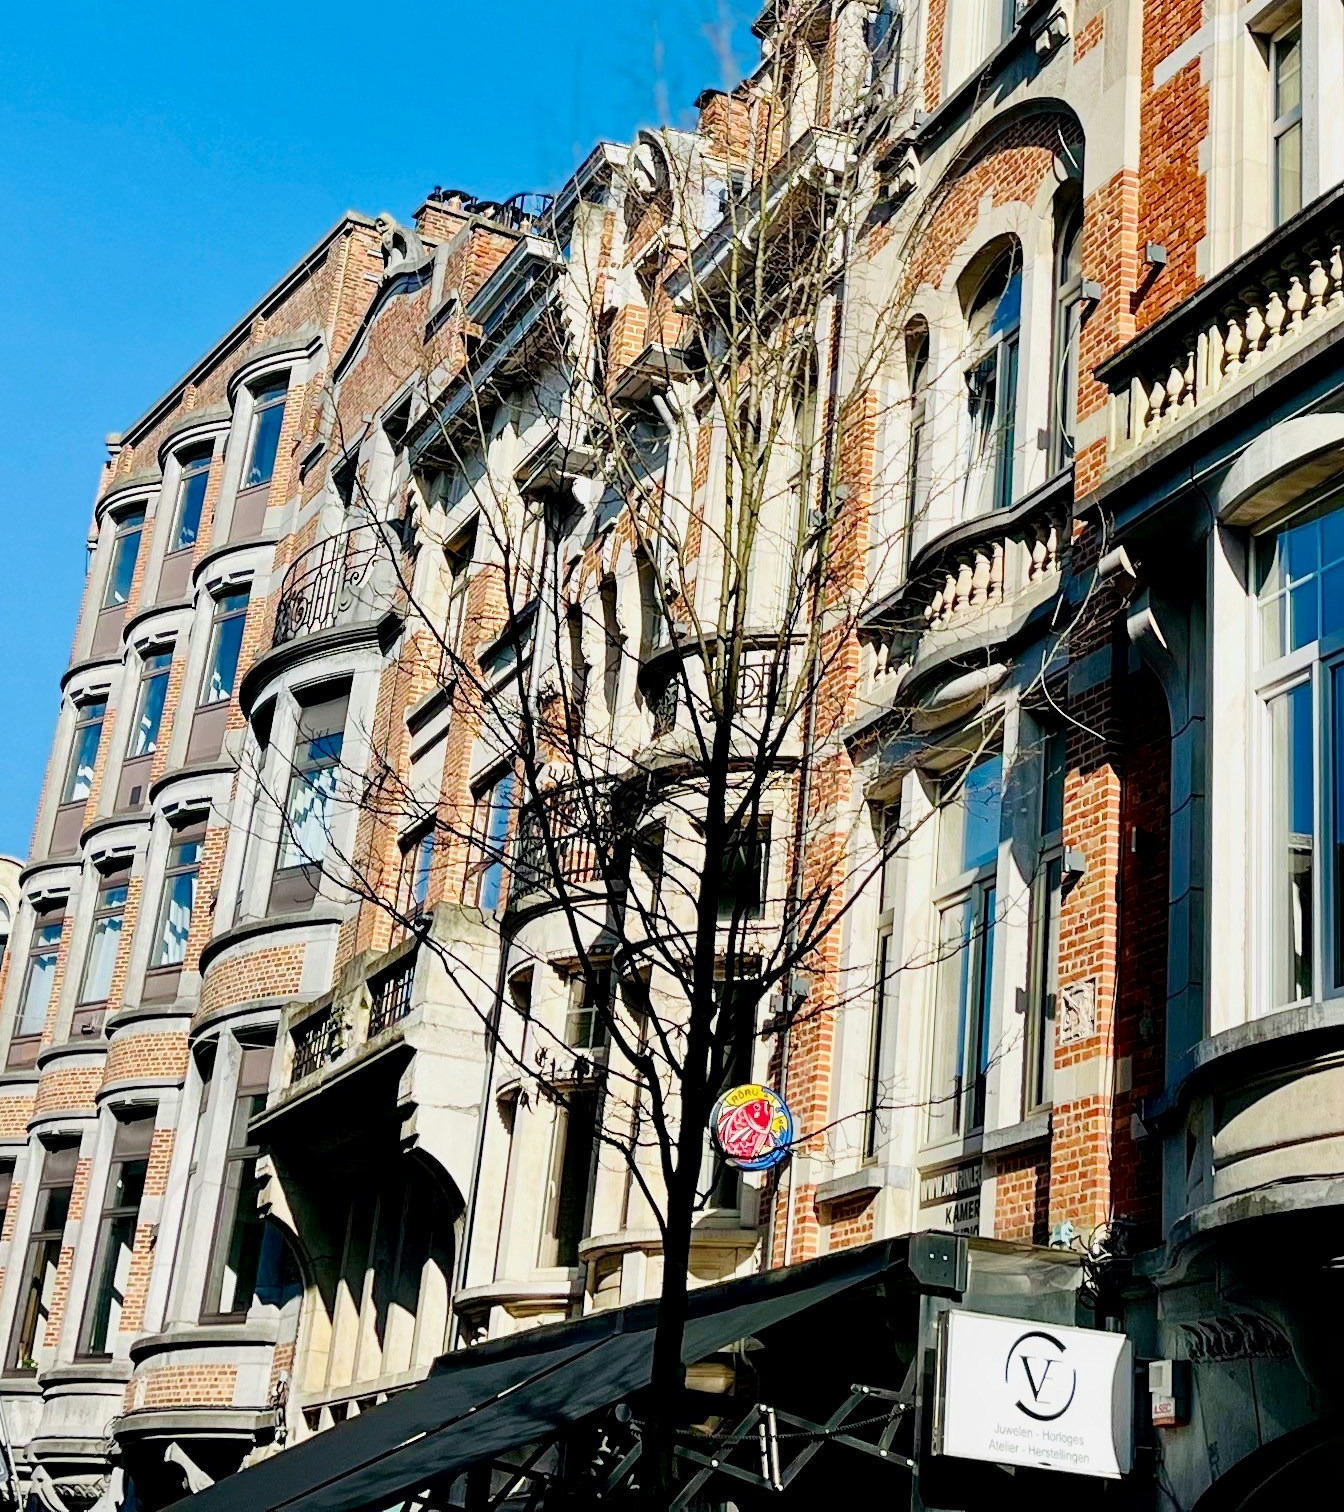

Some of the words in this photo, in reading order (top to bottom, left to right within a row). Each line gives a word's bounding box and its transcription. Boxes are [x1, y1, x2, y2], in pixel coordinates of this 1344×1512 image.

[993, 1423, 1033, 1438] Juwelen
[1042, 1428, 1085, 1446] Horloges
[988, 1439, 1019, 1454] Atelier
[1028, 1445, 1090, 1464] Herstellingen
